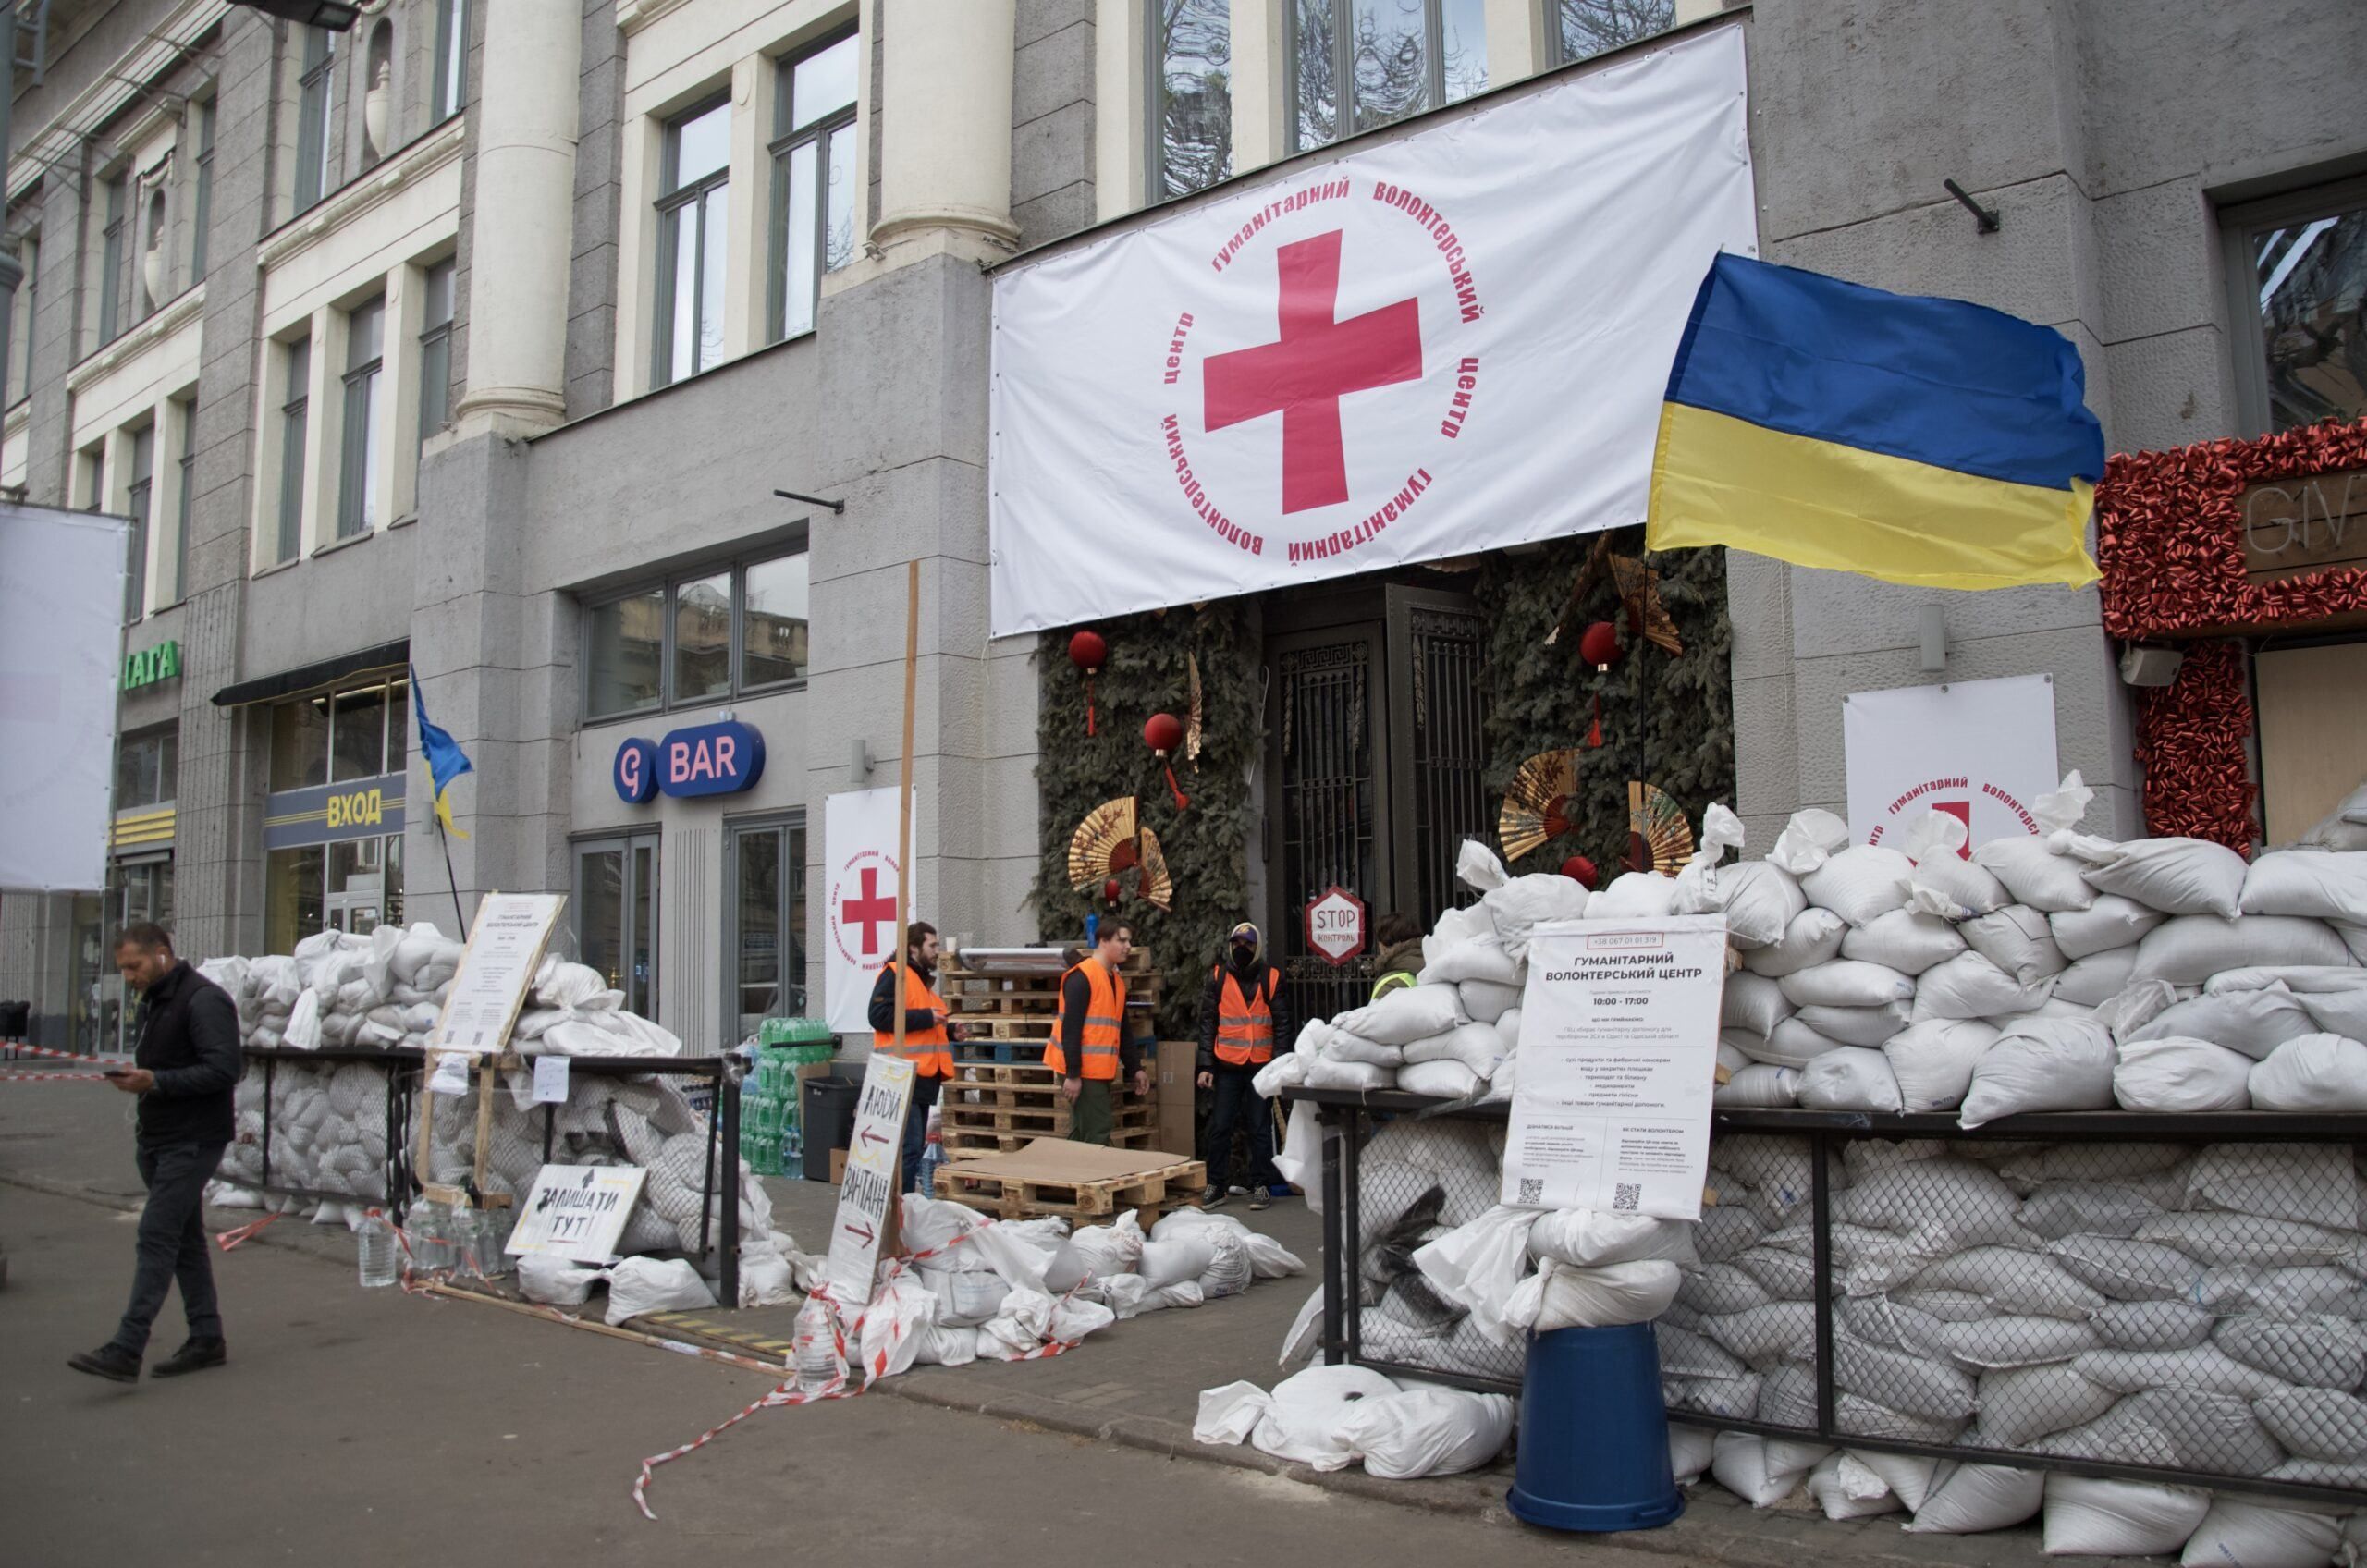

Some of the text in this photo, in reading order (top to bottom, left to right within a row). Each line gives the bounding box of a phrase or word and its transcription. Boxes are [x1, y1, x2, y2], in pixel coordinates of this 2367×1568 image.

[1211, 176, 1485, 439] гуманітарний волонтерський центр
[1160, 312, 1432, 567] гуманітарний волонтерський центр
[670, 736, 737, 784] BAR
[327, 789, 382, 828] ВХОД
[1888, 777, 2040, 835] гуманітарний волонтерс
[1317, 909, 1355, 929] STOP
[1318, 934, 1355, 942] КОНТРОЛЬ
[1545, 967, 1702, 981] ВОЛОНТЕРСЬКИЙ ЦЕНТР
[1575, 951, 1674, 966] ГУМАНІТАРНИЙ
[537, 1188, 619, 1213] ЗАЛИШАТИ
